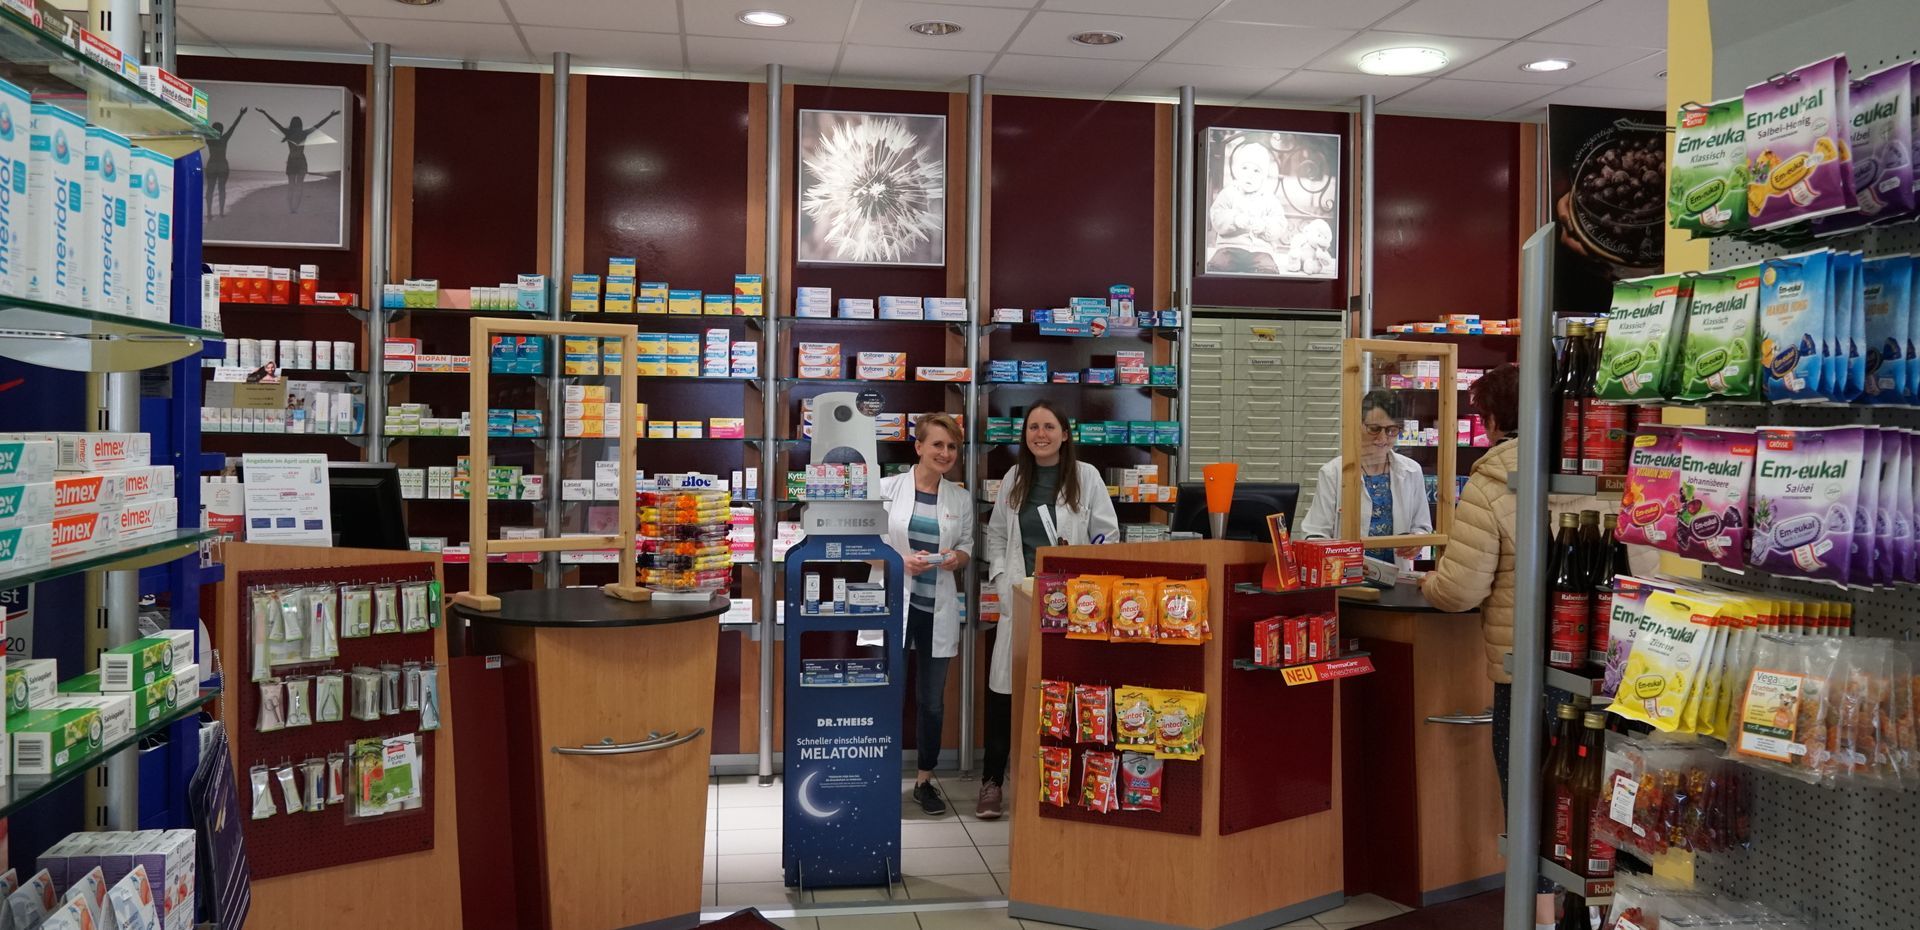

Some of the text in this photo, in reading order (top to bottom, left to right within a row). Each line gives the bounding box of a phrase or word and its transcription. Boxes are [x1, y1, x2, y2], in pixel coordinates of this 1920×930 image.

[1746, 89, 1823, 130] Em-eukal
[1851, 95, 1899, 127] eukal
[54, 176, 68, 287] meridol
[101, 194, 114, 296] meridol
[144, 208, 156, 305] meridol
[1610, 301, 1664, 320] Em-eukal
[1692, 294, 1748, 316] Em-eukal
[94, 437, 125, 457] elmex
[1633, 450, 1680, 468] Em-euka
[1682, 456, 1742, 478] Em-eukal
[1760, 460, 1848, 479] Em-eukal
[682, 476, 711, 487] Bloc
[1688, 477, 1729, 488] Johannisbeere
[1785, 483, 1814, 494] Salbei
[55, 484, 96, 506] elmex
[121, 508, 151, 527] elmex
[52, 522, 92, 543] elmex
[1780, 521, 1816, 538] Em-eukal
[1325, 546, 1361, 554] ThermaCare
[1640, 615, 1697, 644] Em-eukal
[1327, 661, 1358, 670] ThermaCare
[1286, 668, 1312, 683] NEU
[817, 717, 874, 727] DR.THEISS
[834, 736, 877, 745] einschlafen
[387, 753, 406, 762] Zecken
